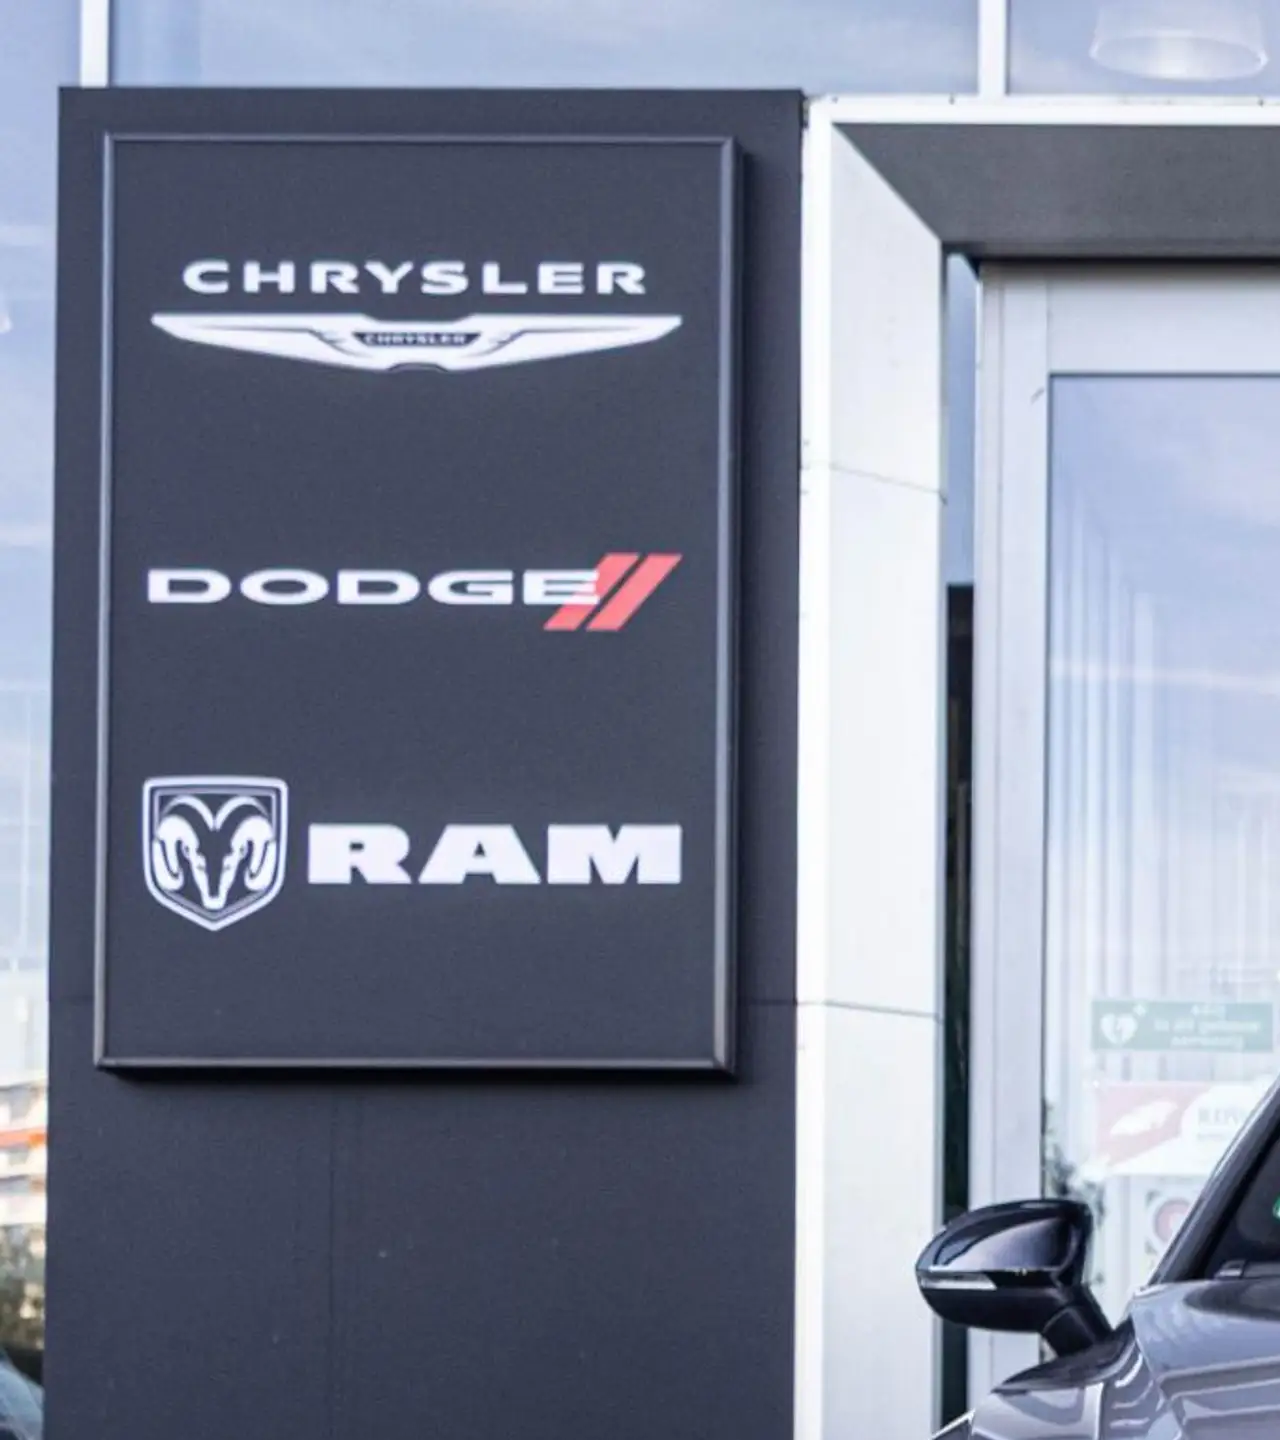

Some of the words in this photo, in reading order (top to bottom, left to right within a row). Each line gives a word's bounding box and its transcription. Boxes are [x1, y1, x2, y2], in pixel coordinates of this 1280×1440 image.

[183, 260, 645, 295] CHRYSLER
[147, 568, 601, 605] DODGE
[307, 823, 682, 885] RAM
